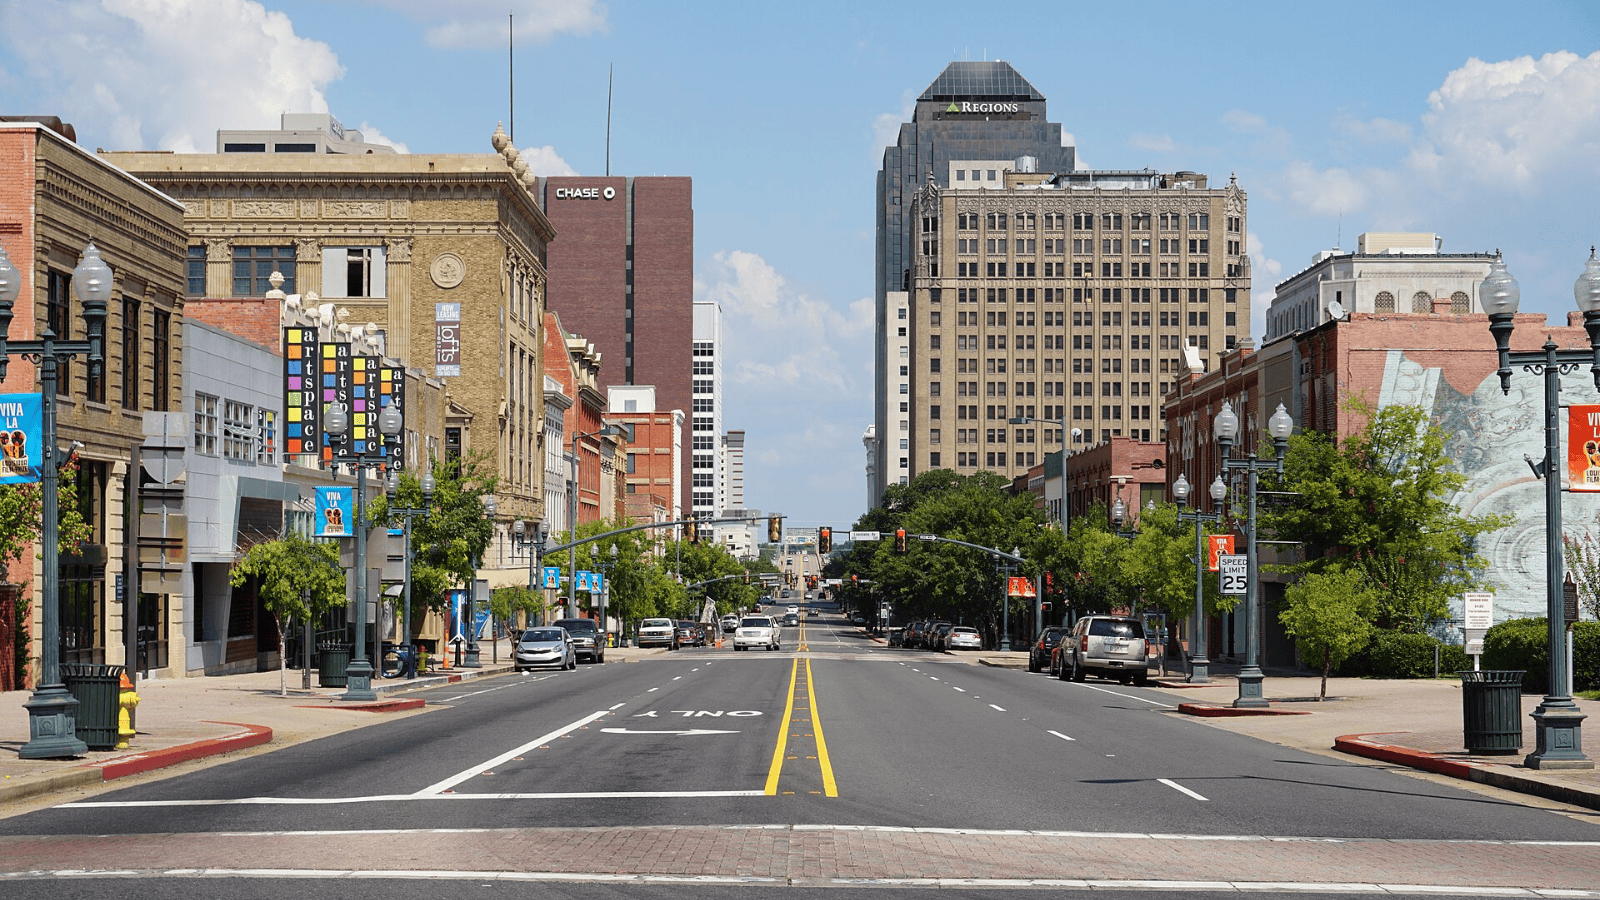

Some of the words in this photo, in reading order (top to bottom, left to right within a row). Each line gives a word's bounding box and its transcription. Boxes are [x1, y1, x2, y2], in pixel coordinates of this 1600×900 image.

[556, 188, 599, 198] CHASE
[442, 324, 460, 362] lofts
[304, 330, 314, 452] artspace
[338, 346, 348, 456] artspce
[367, 360, 377, 451] artspac
[0, 403, 24, 416] VIVA
[6, 417, 18, 428] LA
[326, 492, 341, 500] VIVA
[1223, 576, 1247, 590] 25
[632, 710, 764, 718] ONLY
